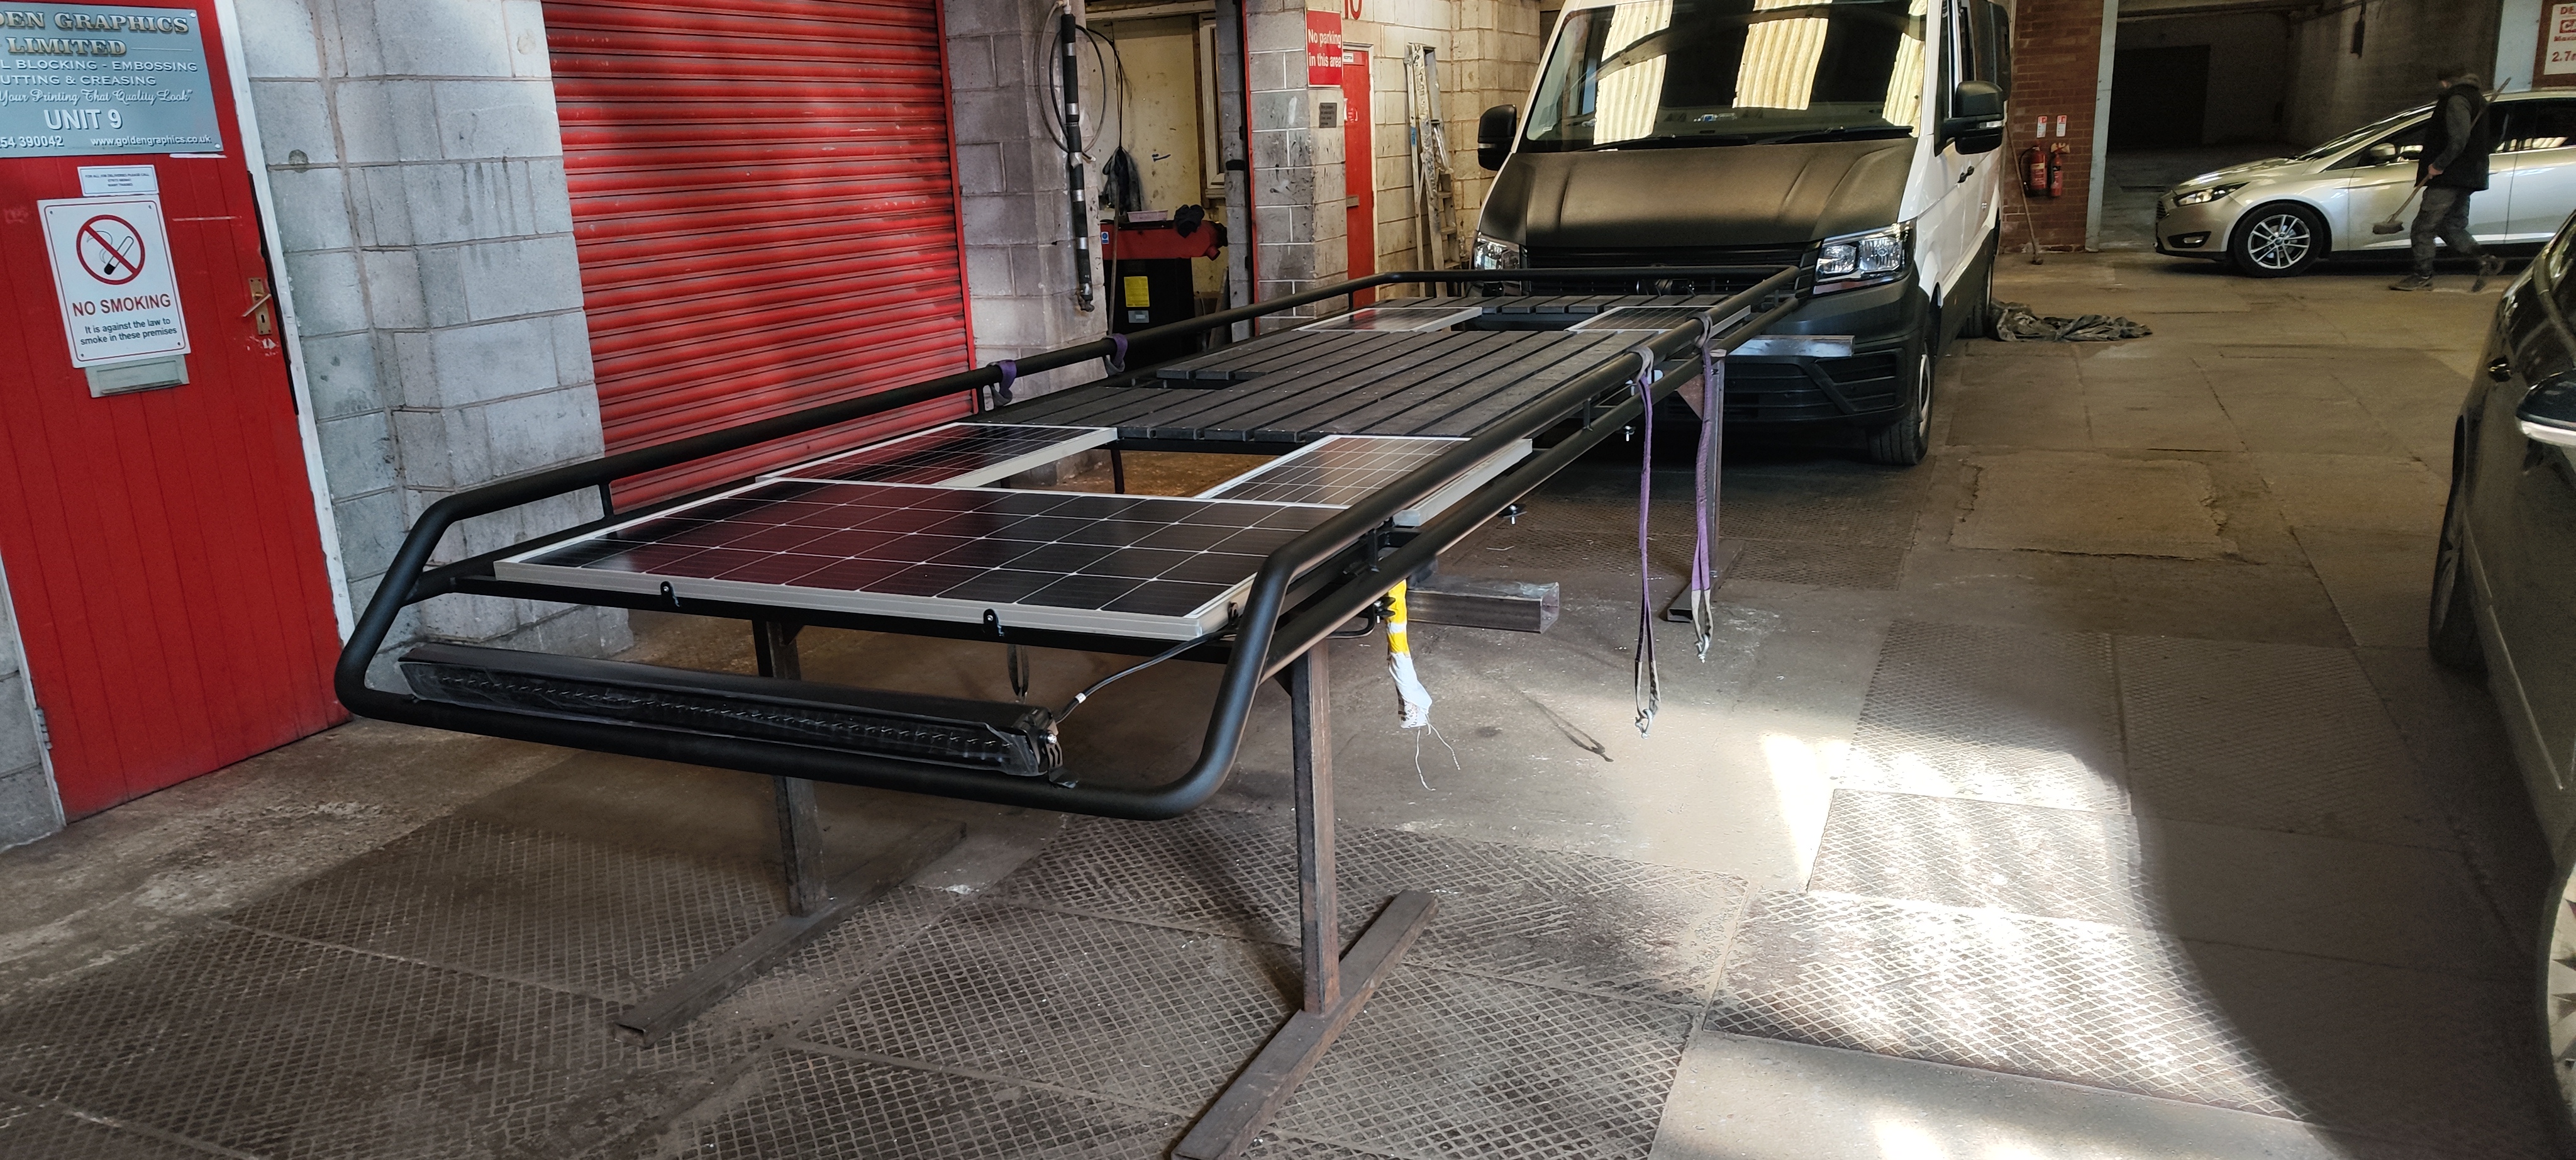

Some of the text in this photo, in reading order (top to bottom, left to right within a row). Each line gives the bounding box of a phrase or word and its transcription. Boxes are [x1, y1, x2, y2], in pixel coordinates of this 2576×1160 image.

[54, 12, 189, 33] GRAPHICS
[6, 37, 127, 55] LIMITED
[1308, 28, 1341, 48] No parking
[16, 59, 98, 71] BLOCKING
[112, 60, 197, 72] EMBOSSING
[1309, 52, 1341, 67] in this area
[65, 75, 77, 86] &
[80, 75, 157, 86] CREASING
[30, 89, 80, 105] Printing
[81, 89, 111, 103] That
[113, 89, 157, 106] Quality
[44, 109, 123, 130] UNIT 9
[0, 135, 212, 148] 54 390042 www.goldengraphics.co.uk
[72, 293, 171, 316] NO SMOKING
[80, 335, 108, 345] smoke
[142, 327, 177, 339] premises
[85, 326, 91, 334] It
[93, 325, 101, 333] is
[103, 321, 132, 333] against
